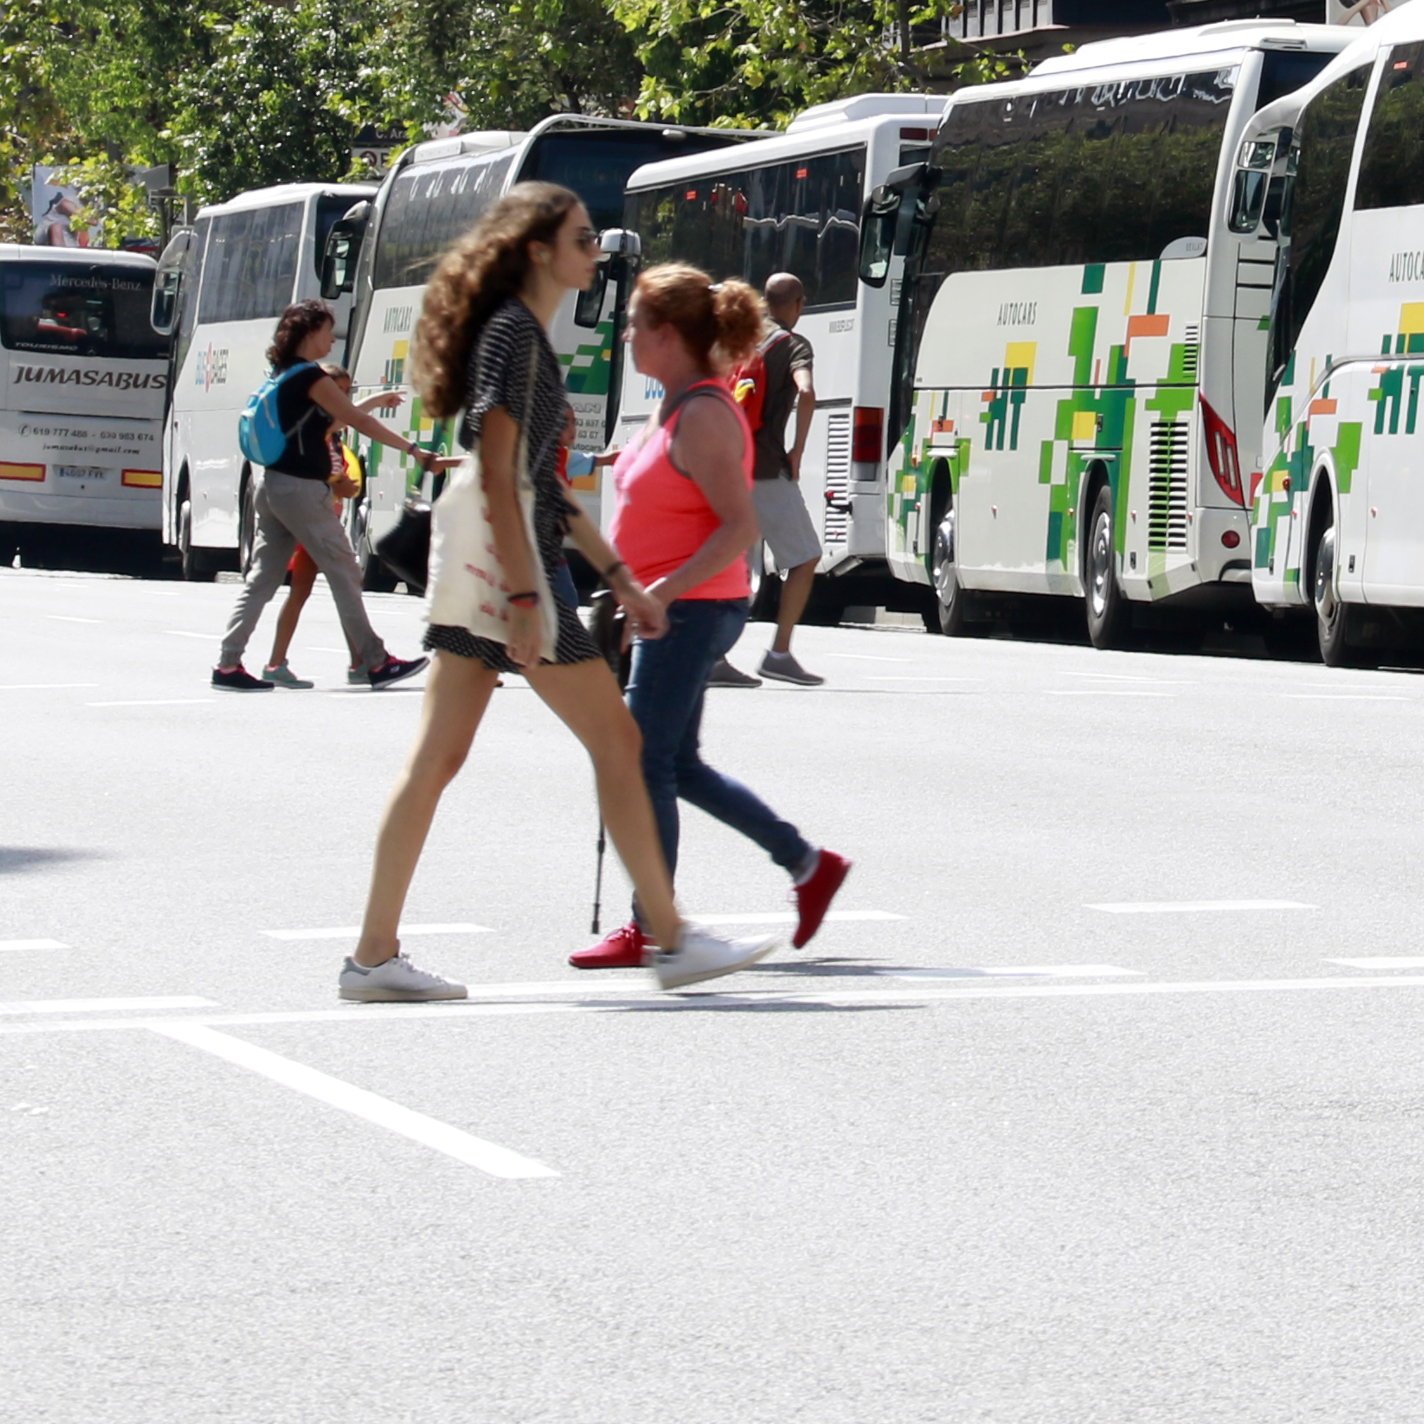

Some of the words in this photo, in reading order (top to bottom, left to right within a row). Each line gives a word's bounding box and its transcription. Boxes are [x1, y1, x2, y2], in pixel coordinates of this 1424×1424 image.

[50, 275, 142, 291] Mercedes-Benz
[996, 301, 1038, 326] AUTOCARS
[13, 366, 168, 390] JUMASABUS
[53, 429, 70, 437] 777
